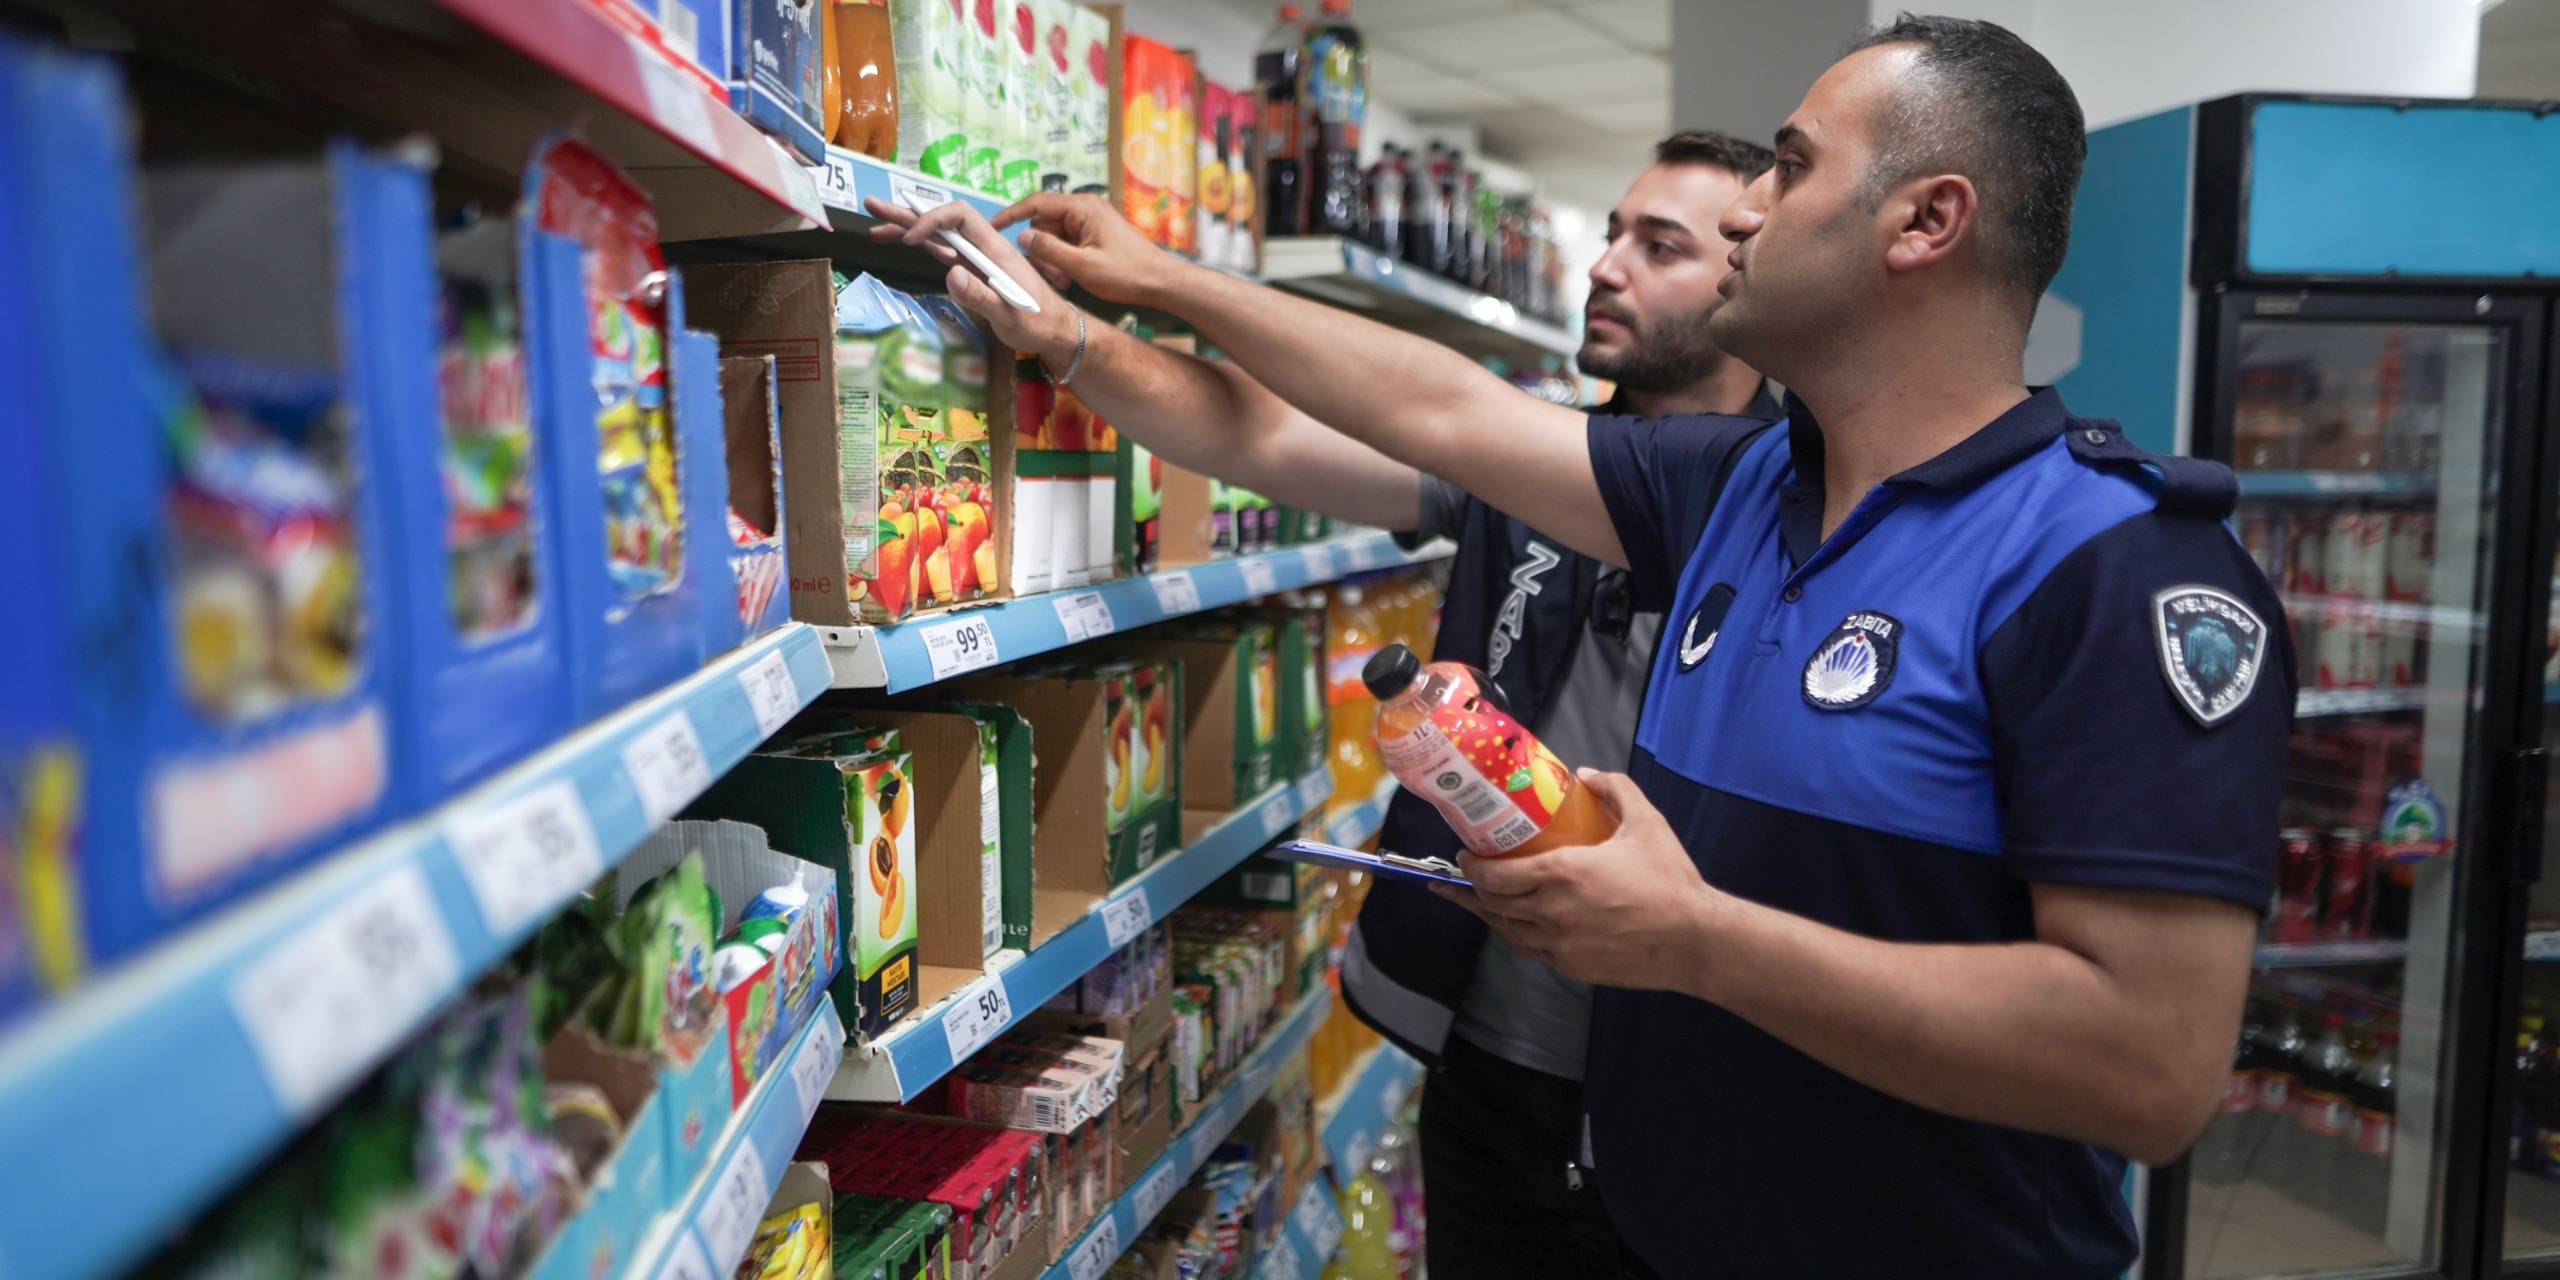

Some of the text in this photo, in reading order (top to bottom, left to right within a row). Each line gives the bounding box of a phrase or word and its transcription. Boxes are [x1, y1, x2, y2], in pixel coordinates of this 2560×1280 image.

[824, 162, 846, 191] 75
[803, 578, 816, 592] ml
[1842, 614, 1893, 639] ZABITA
[984, 636, 993, 647] TL
[978, 989, 999, 1021] 50
